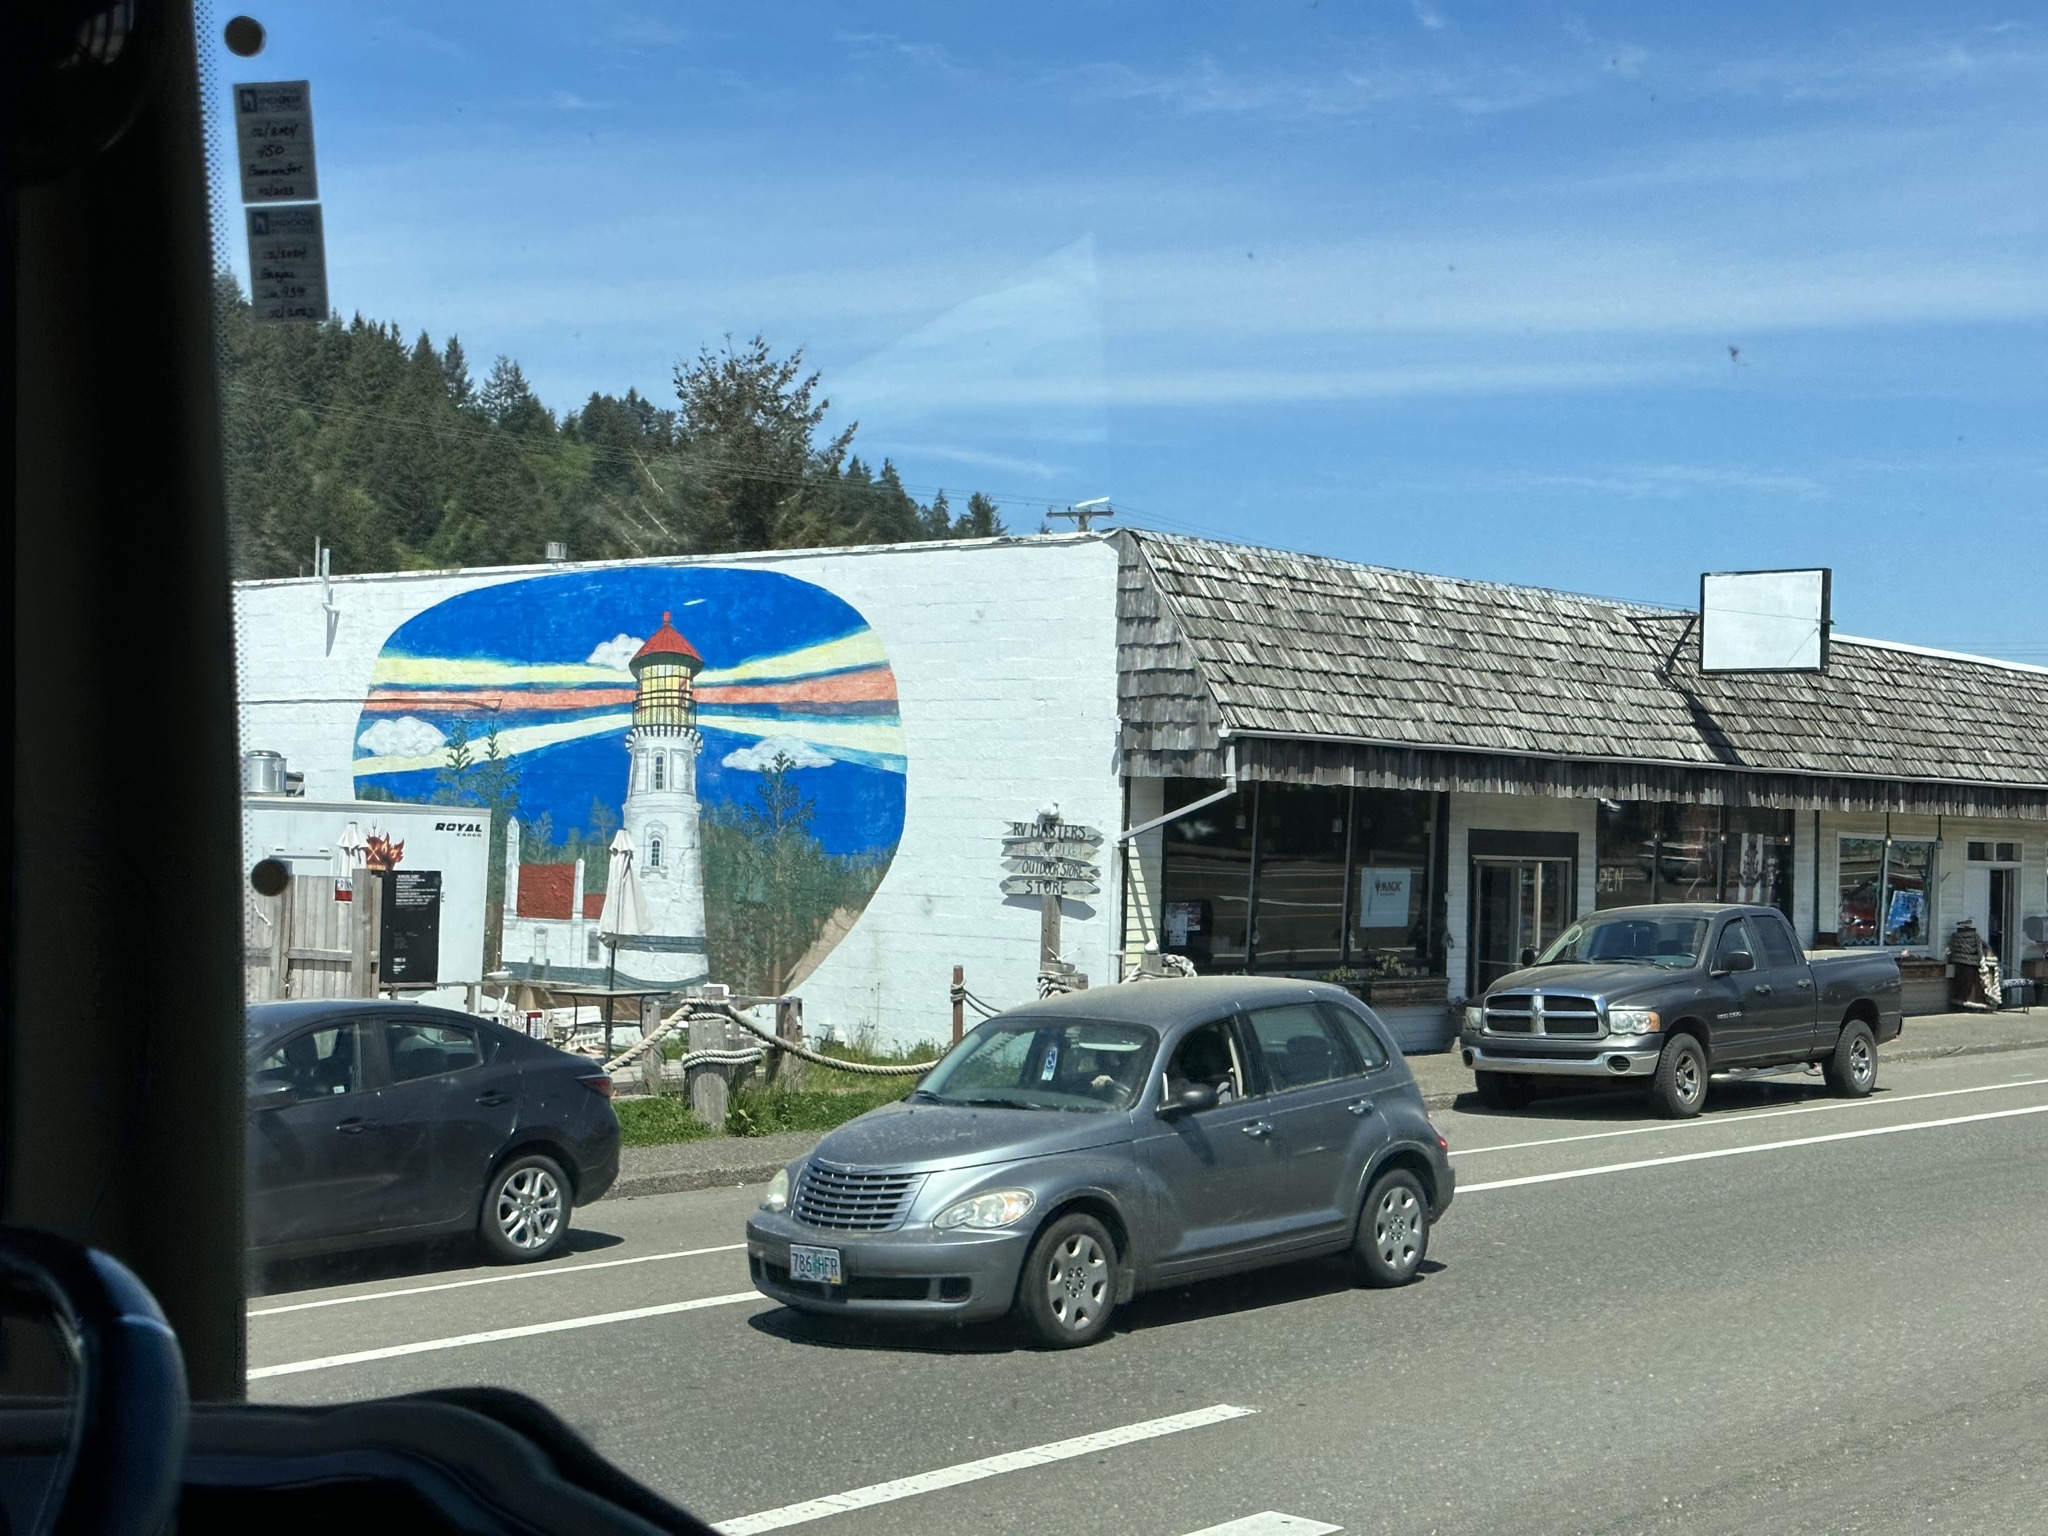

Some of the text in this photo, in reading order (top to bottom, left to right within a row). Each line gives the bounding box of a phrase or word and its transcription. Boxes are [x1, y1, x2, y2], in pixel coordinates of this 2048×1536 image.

[435, 822, 482, 832] ROYAL
[1013, 822, 1086, 839] RV MASTERS
[1022, 860, 1082, 878] OUTDOOR STORE
[1025, 880, 1068, 894] STORE
[792, 1253, 838, 1275] 786 HFR
